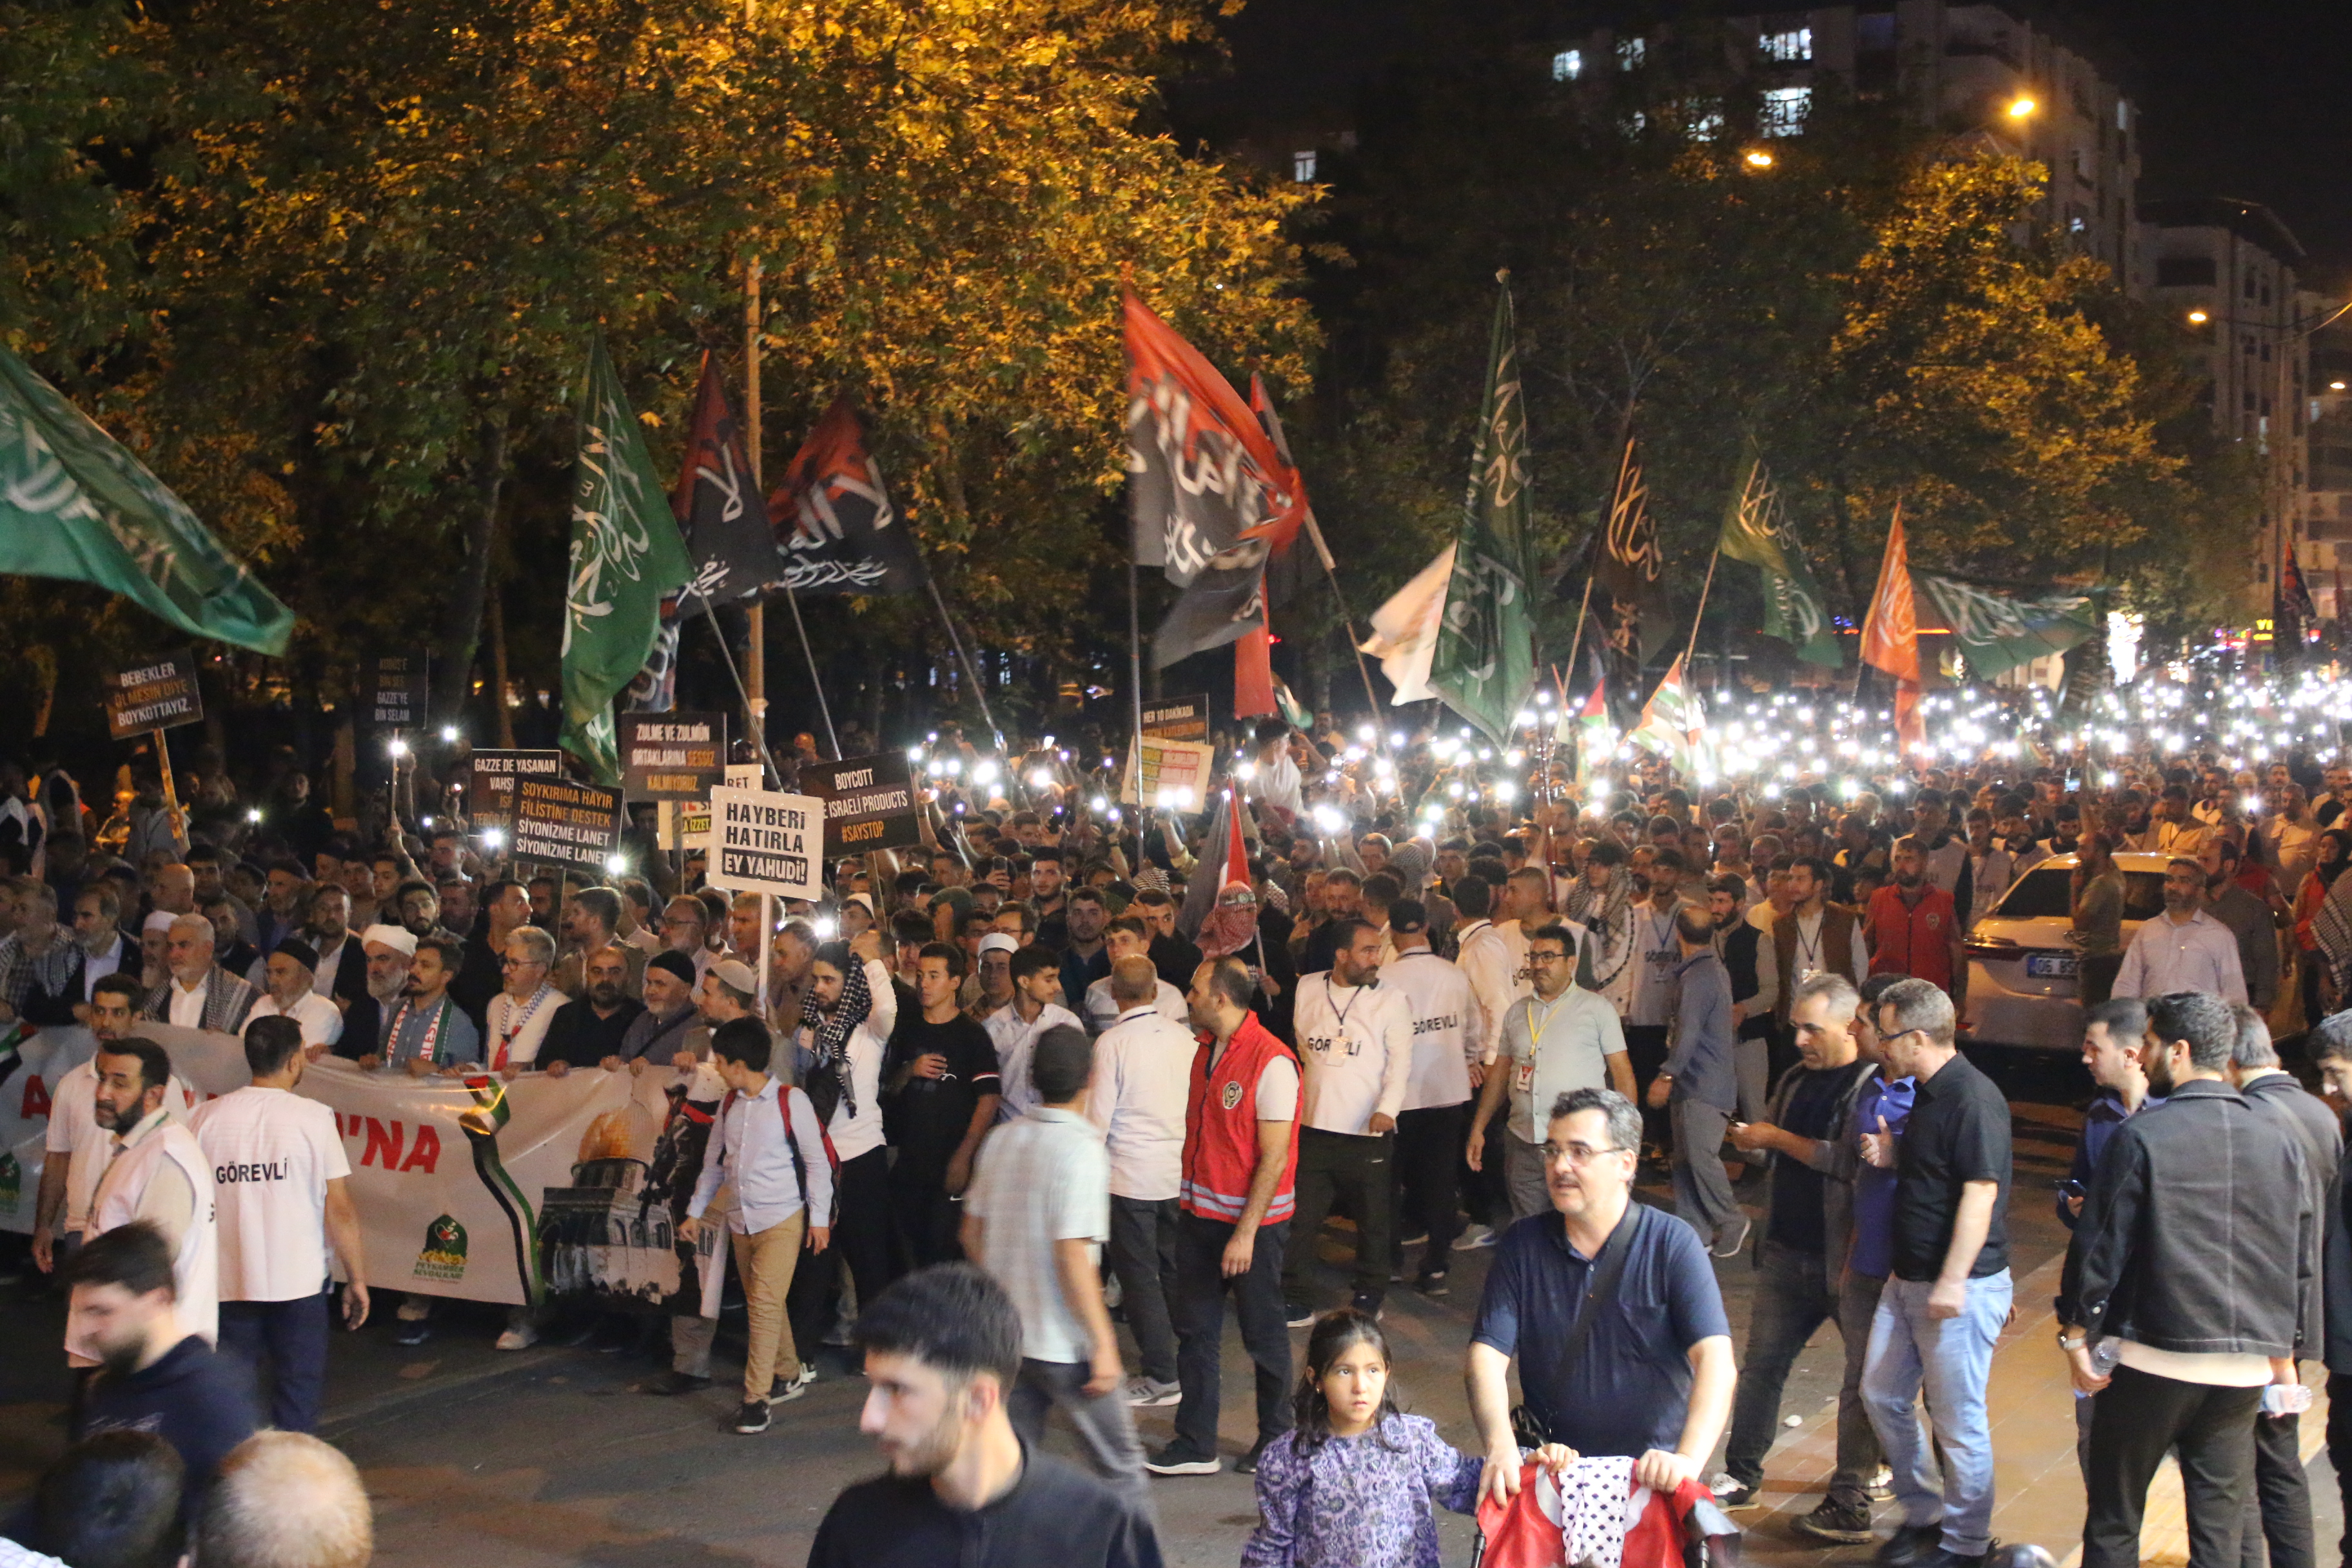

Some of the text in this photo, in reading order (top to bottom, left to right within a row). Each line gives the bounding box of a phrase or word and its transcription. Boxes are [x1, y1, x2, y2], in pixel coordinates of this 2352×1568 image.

[120, 662, 176, 687] BEBEKLER
[475, 758, 556, 774] GAZZE DE YAŞANAN
[835, 769, 873, 791] BOYCOTT
[522, 781, 613, 809] SOYKIRIMA HAYIR
[862, 790, 908, 813] PRODUCTS
[571, 809, 611, 828] DESTEK
[518, 818, 611, 847] SİYONİZME LANET
[726, 826, 804, 854] HATIRLA
[841, 821, 885, 843] #SAYSTOP
[516, 837, 609, 867] SİYONİZME LANET
[725, 853, 743, 873] EY
[216, 1157, 288, 1184] GÖREVLİ
